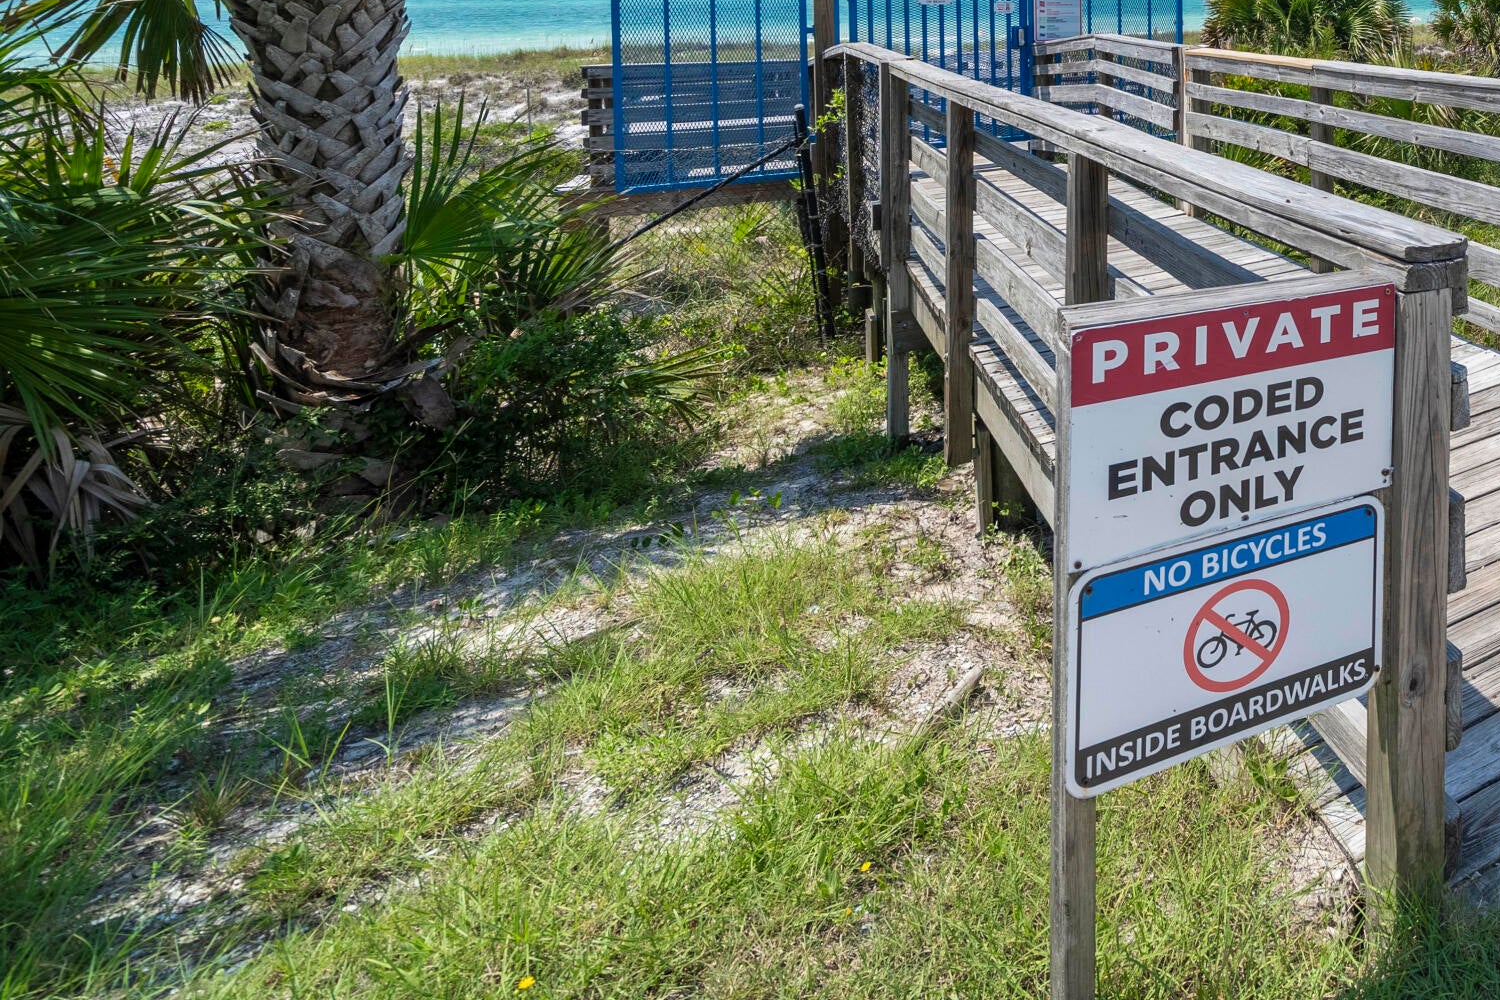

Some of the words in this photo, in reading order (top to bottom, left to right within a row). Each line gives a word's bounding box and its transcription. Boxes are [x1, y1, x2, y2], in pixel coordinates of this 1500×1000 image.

[1091, 298, 1380, 384] PRIVATE
[1160, 376, 1325, 438] CODED
[1107, 408, 1365, 501] ENTRANCE
[1179, 465, 1305, 527] ONLY
[1142, 560, 1192, 596] NO
[1202, 522, 1327, 578] BICYCLES
[1086, 724, 1182, 780] INSIDE
[1190, 658, 1367, 741] BOARDWALKS
